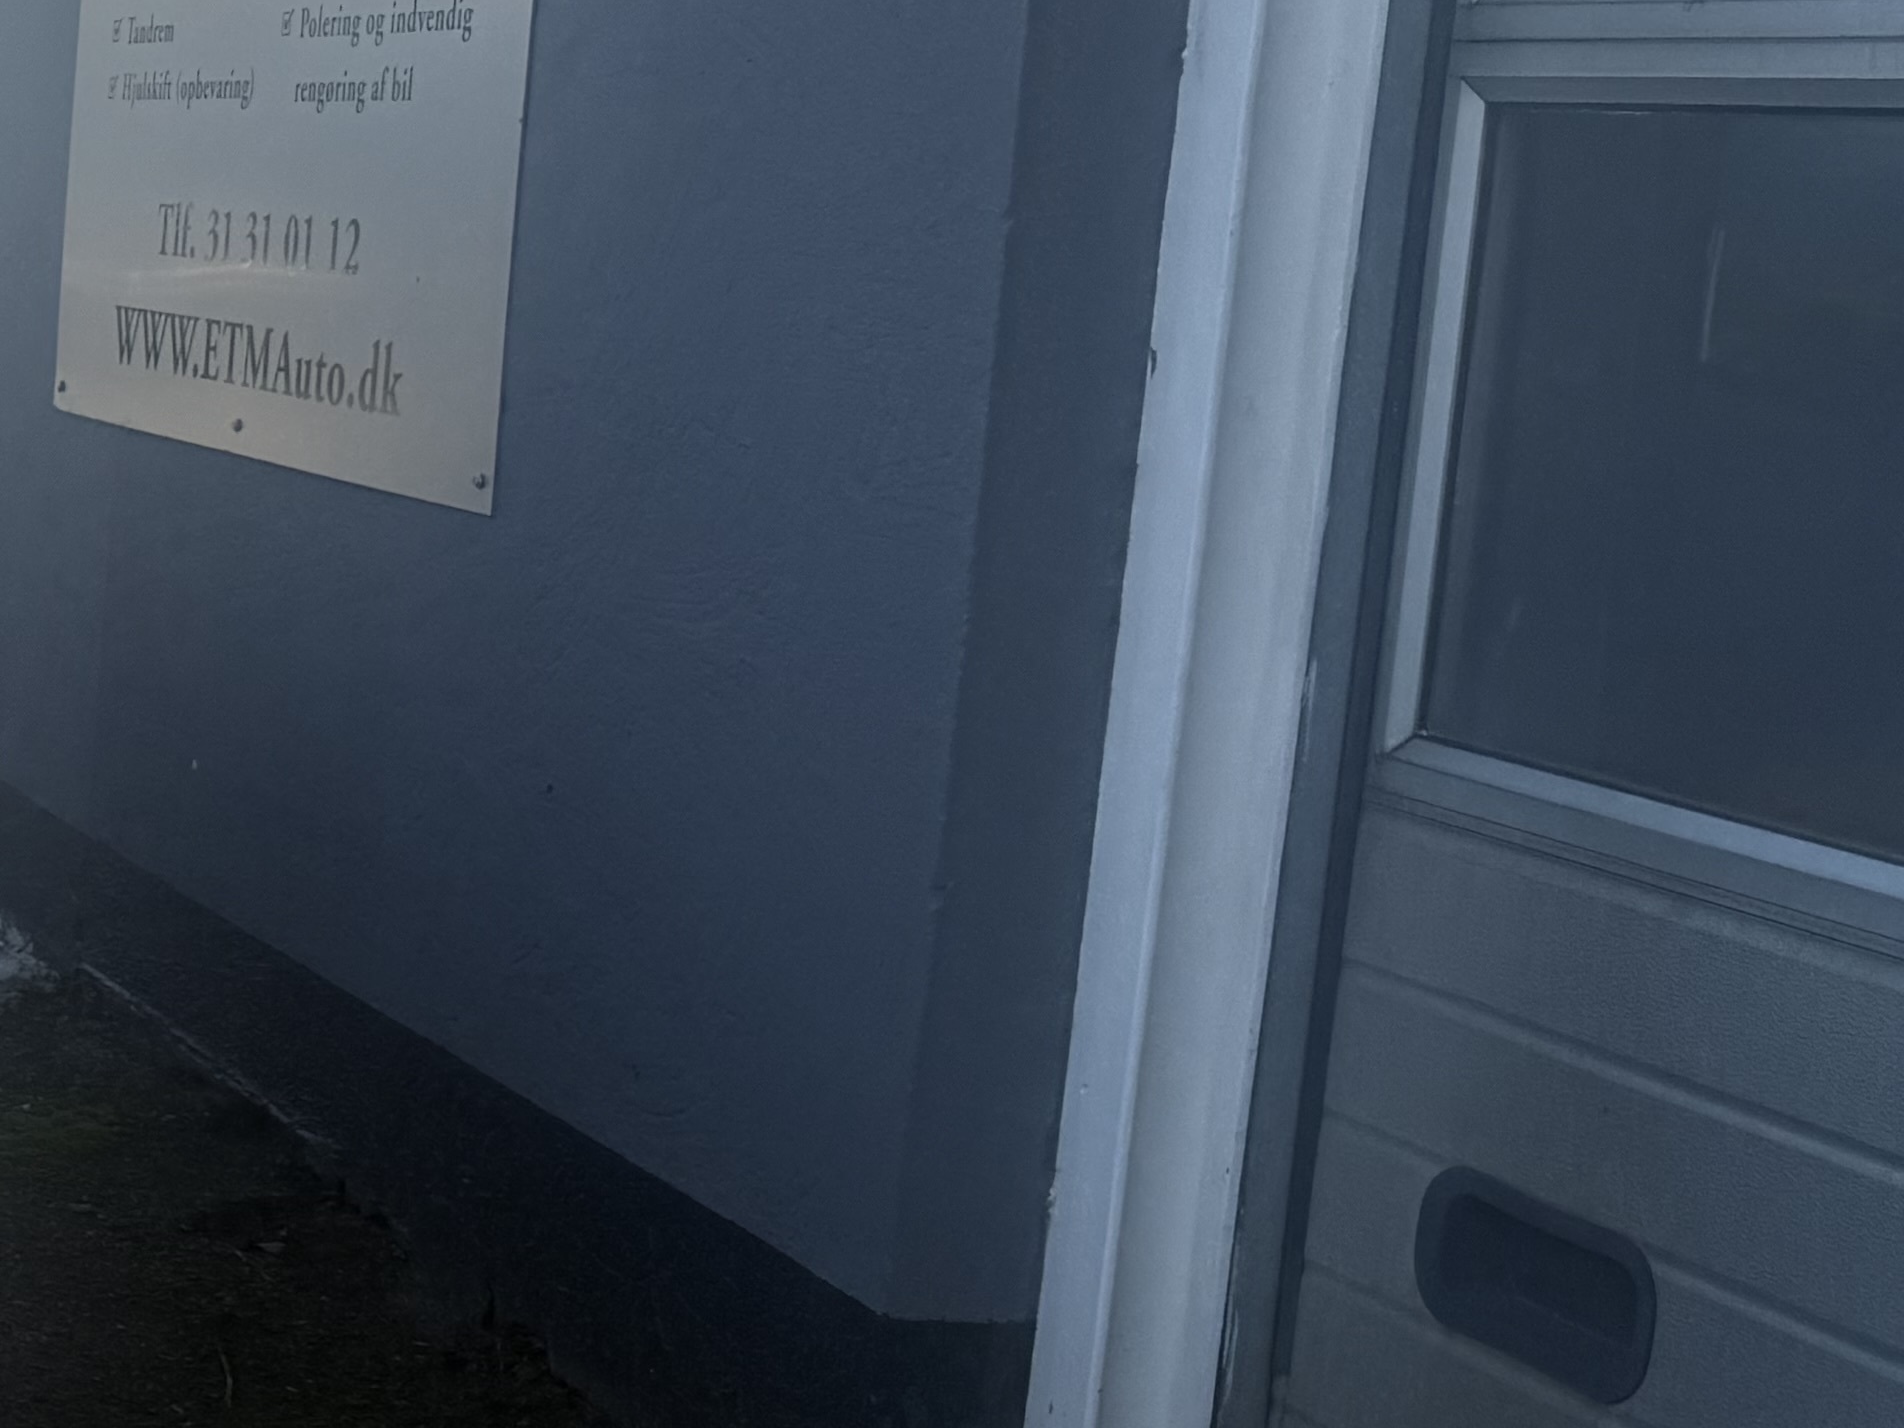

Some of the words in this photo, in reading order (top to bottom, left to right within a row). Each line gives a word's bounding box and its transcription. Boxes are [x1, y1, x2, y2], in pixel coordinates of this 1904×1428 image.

[127, 13, 175, 45] Tandrem
[299, 3, 361, 48] Polering
[365, 13, 386, 47] og
[122, 69, 172, 119] Hjulskift
[176, 67, 255, 120] (opbevaring)
[294, 69, 367, 114] rengøring
[370, 65, 390, 102] af
[391, 65, 414, 102] bil
[158, 202, 196, 258] Tlf.
[204, 208, 233, 262] 31
[243, 210, 272, 265] 31
[283, 214, 313, 270] 01
[331, 216, 362, 275] 12
[115, 305, 403, 416] WWW.ETMAuto.dk
